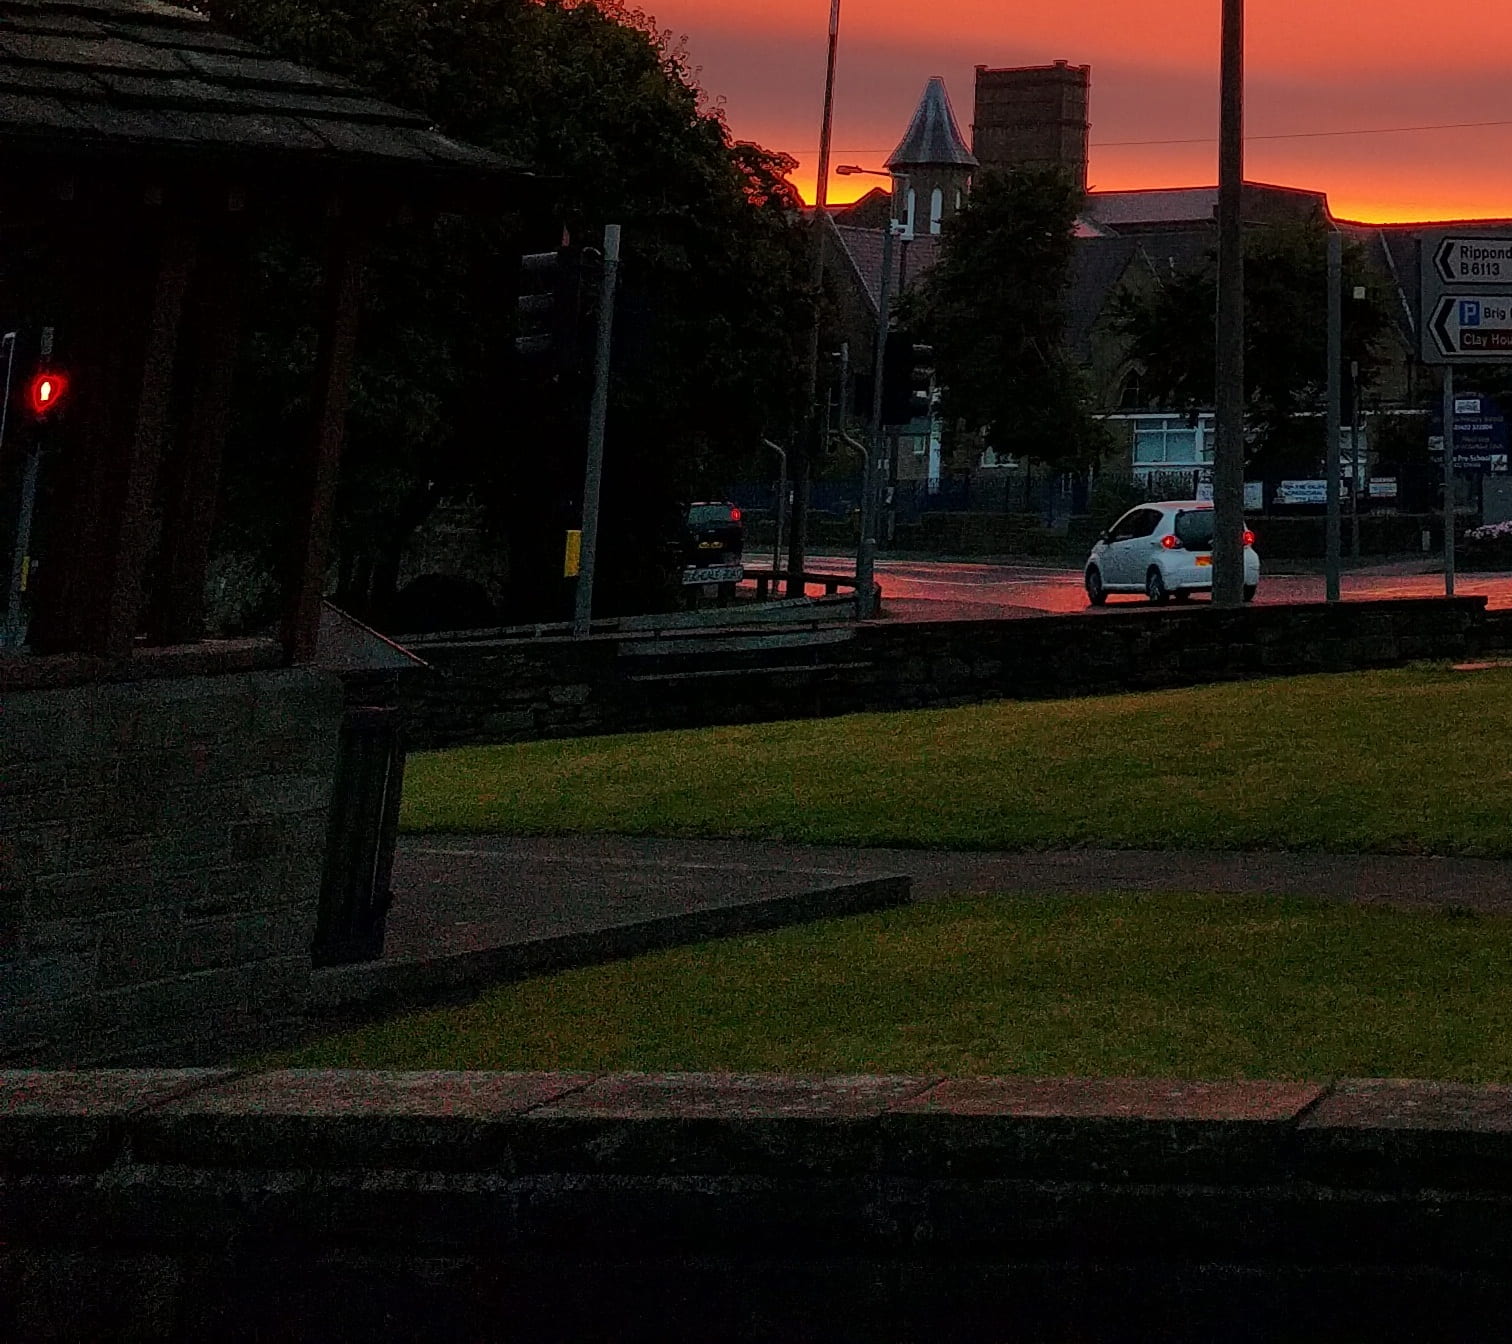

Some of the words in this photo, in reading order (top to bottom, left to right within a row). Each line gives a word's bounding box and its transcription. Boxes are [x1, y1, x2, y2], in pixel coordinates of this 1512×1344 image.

[1460, 262, 1469, 275] B
[1472, 262, 1500, 276] 6113
[1484, 307, 1506, 320] Brig
[1463, 333, 1487, 347] Clay
